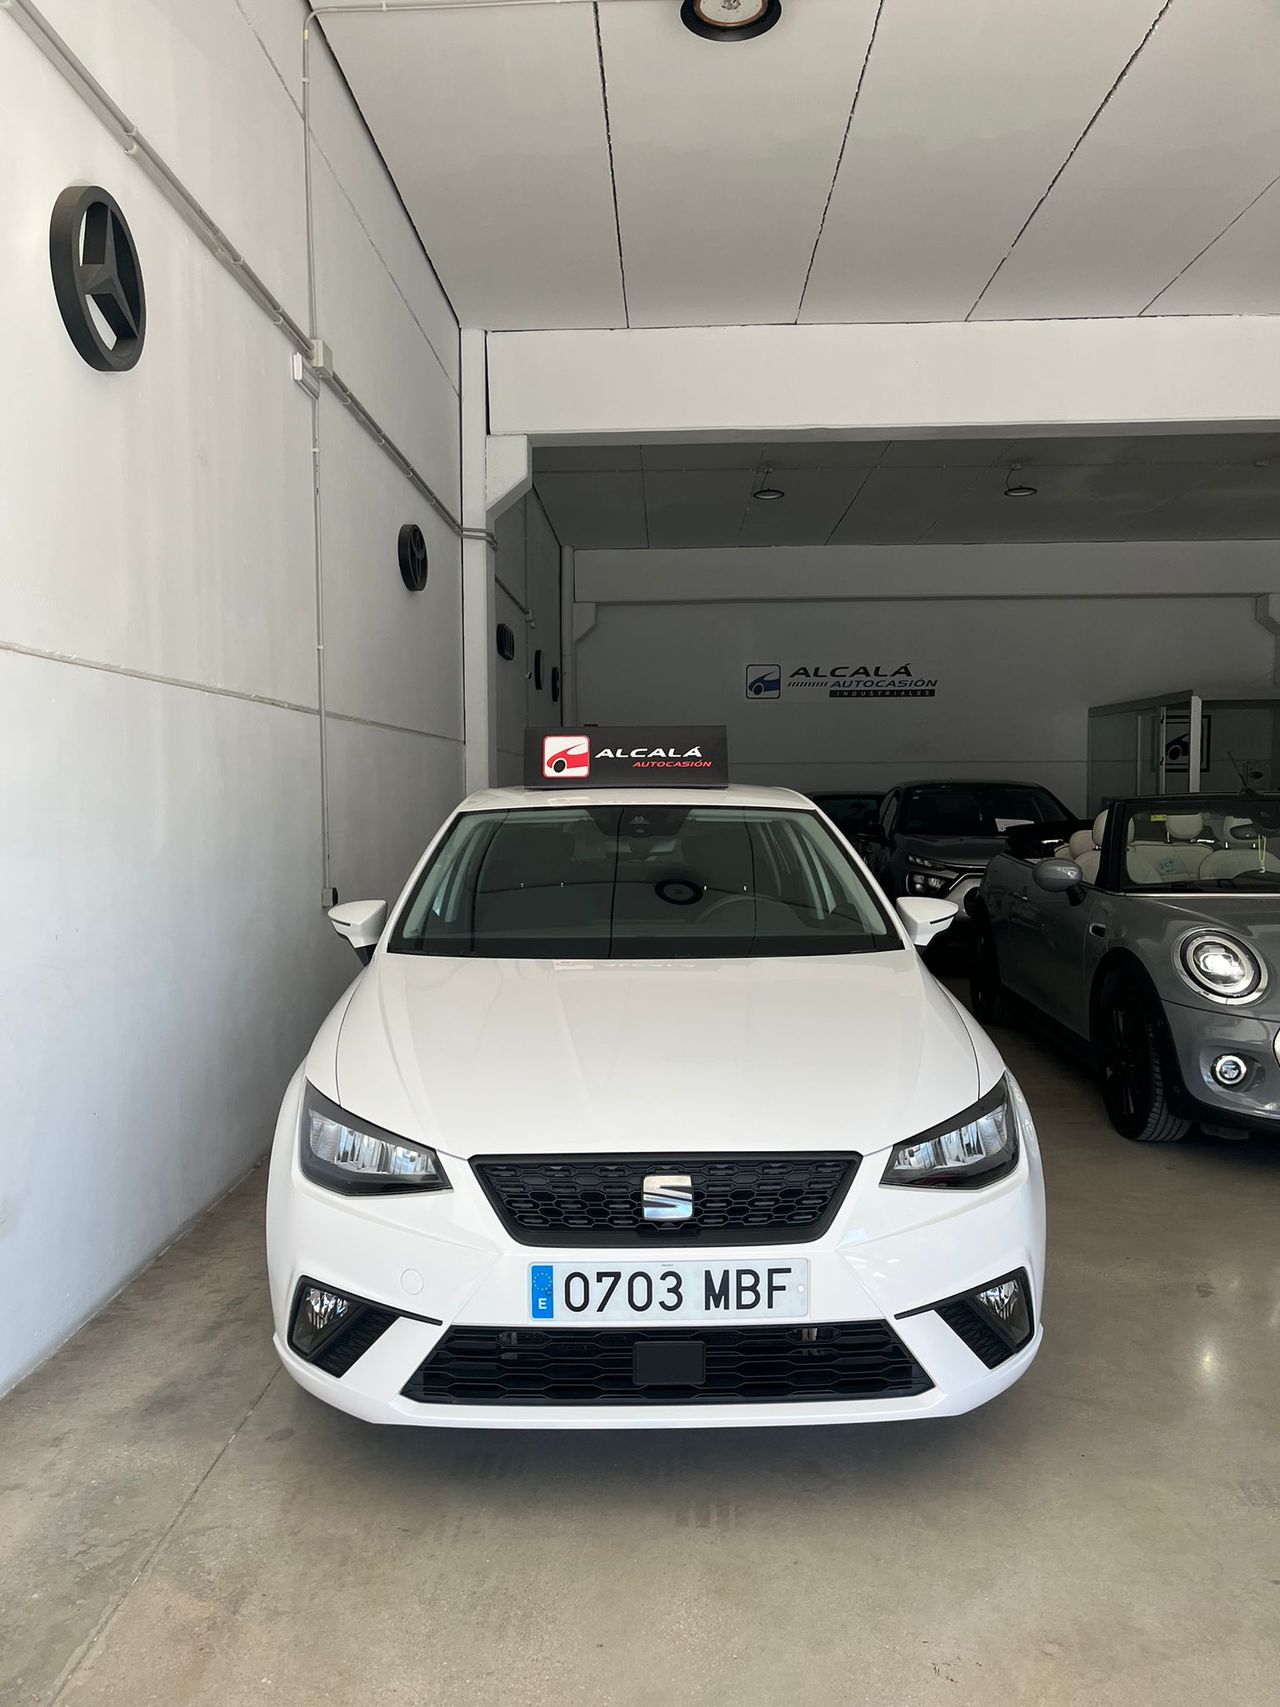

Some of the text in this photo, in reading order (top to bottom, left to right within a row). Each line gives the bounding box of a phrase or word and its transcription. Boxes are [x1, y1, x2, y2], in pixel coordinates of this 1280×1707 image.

[789, 663, 912, 677] ALCALÁ
[830, 677, 938, 688] AUTOCASIÓN
[594, 746, 703, 758] ALCALÁ
[632, 759, 712, 768] AUTOCASIÓN
[564, 1268, 792, 1313] 0703 MBF
[537, 1298, 547, 1310] E
